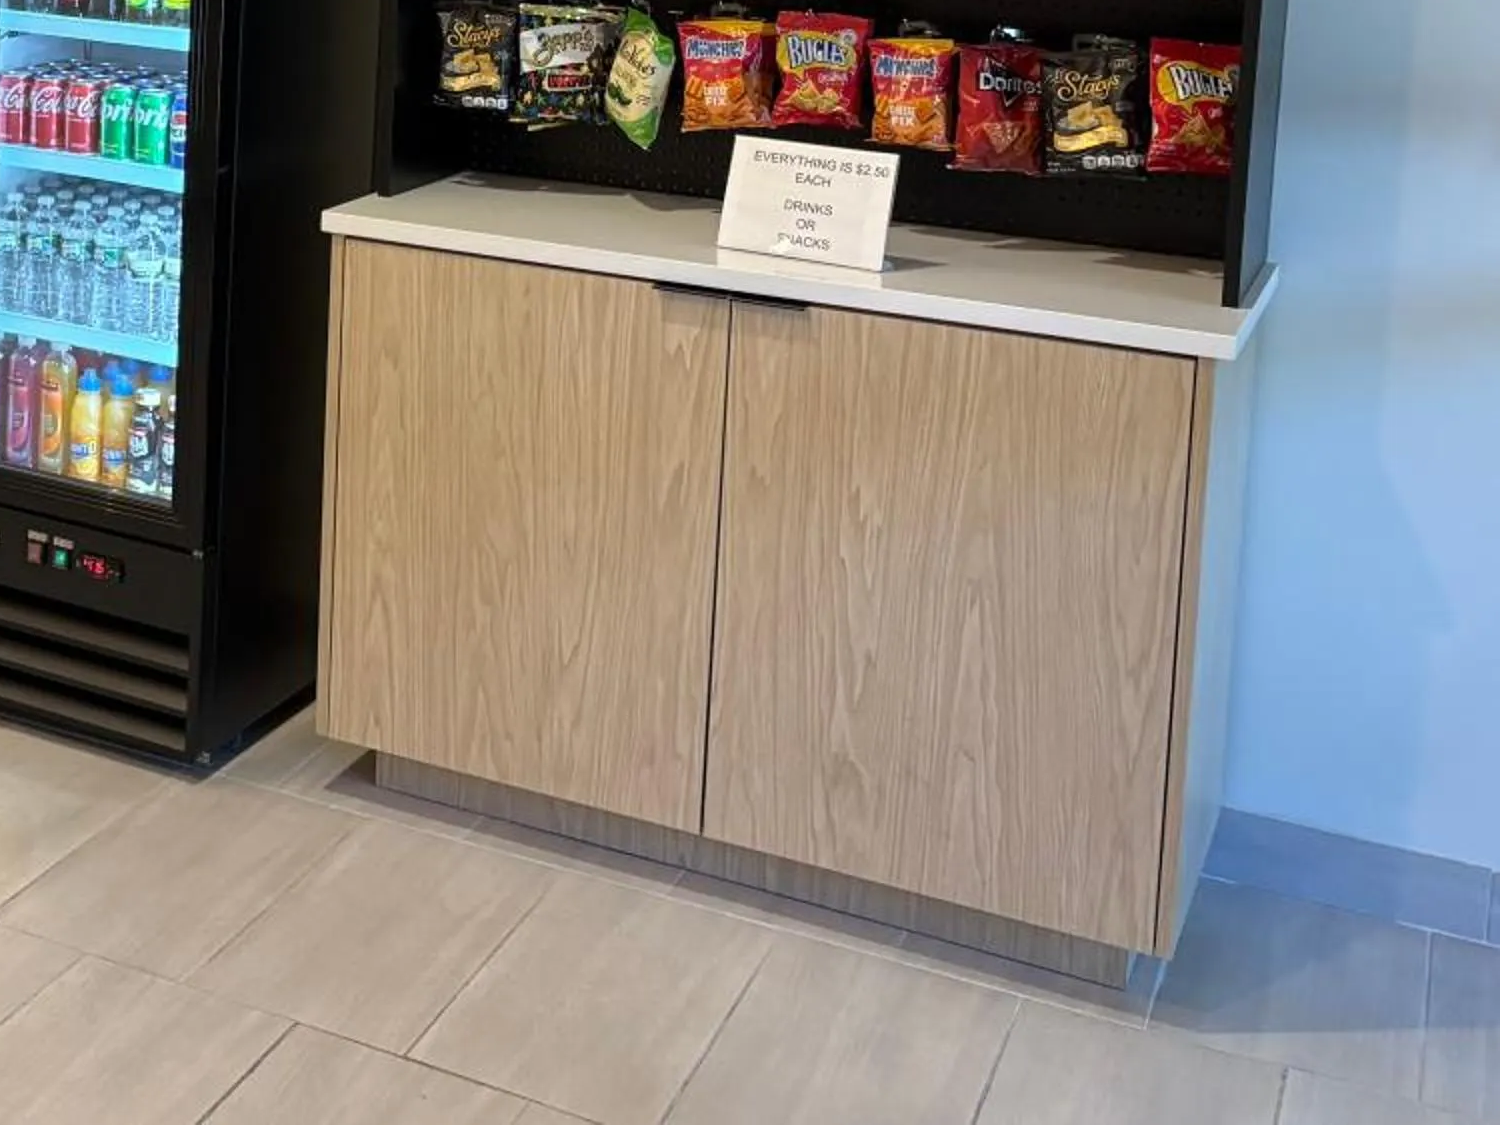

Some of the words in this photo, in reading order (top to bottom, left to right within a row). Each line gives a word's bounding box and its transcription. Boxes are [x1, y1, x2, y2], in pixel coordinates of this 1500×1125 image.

[979, 72, 1042, 94] Doritos
[754, 150, 837, 172] EVERYTHING
[840, 162, 852, 174] IS
[795, 172, 832, 187] EACH
[783, 199, 833, 216] DRINKS
[796, 218, 816, 231] OR
